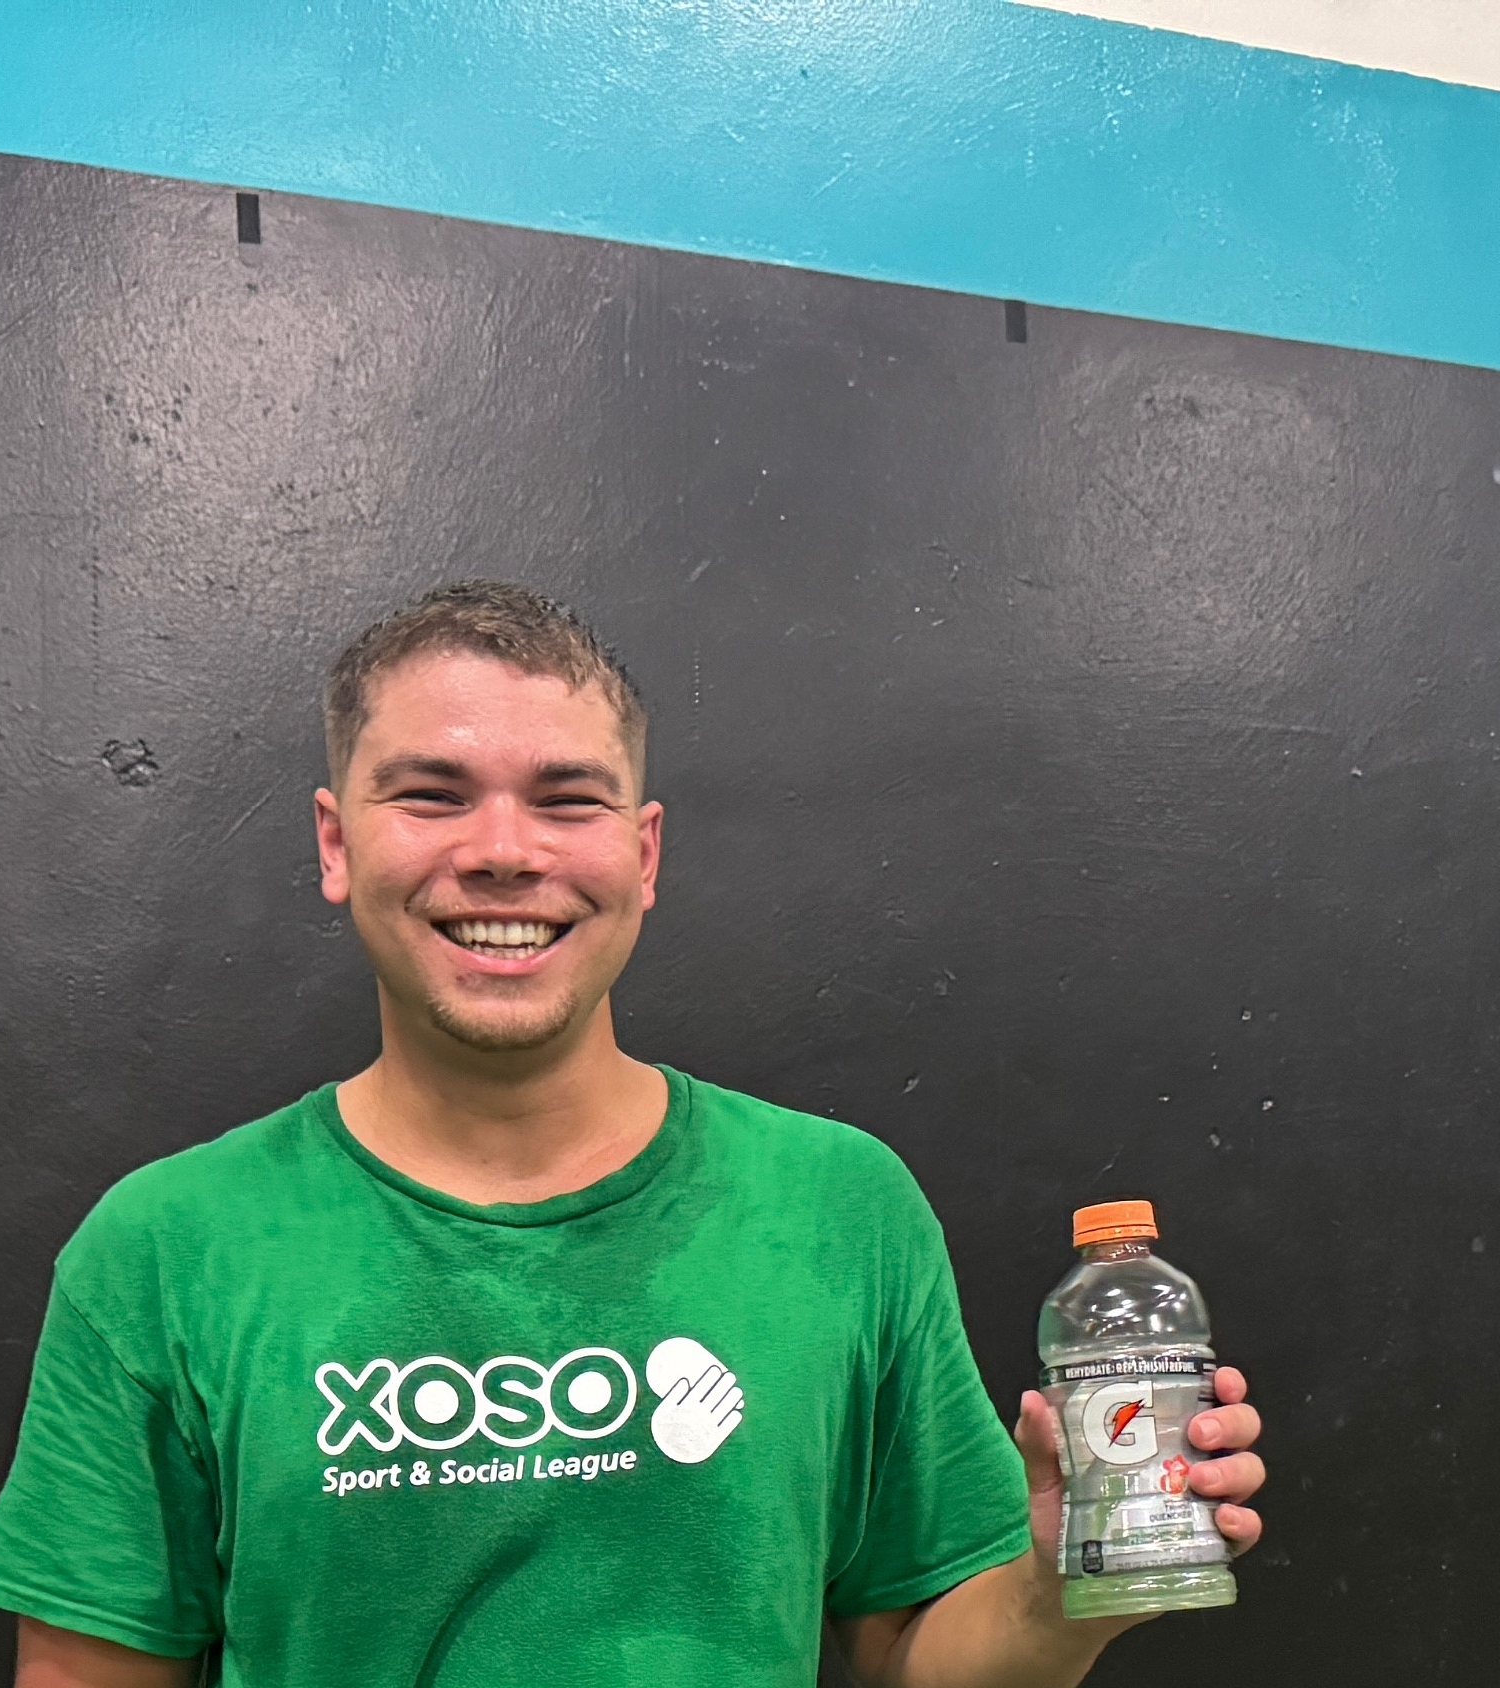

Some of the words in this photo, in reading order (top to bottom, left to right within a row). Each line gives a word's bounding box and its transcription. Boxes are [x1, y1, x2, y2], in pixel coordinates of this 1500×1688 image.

[314, 1347, 637, 1456] XOSO
[1066, 1364, 1111, 1379] REHYDRATE
[1082, 1381, 1158, 1465] G
[322, 1464, 401, 1496] Sport
[409, 1460, 431, 1486] &
[439, 1455, 524, 1485] Social
[533, 1450, 637, 1480] League
